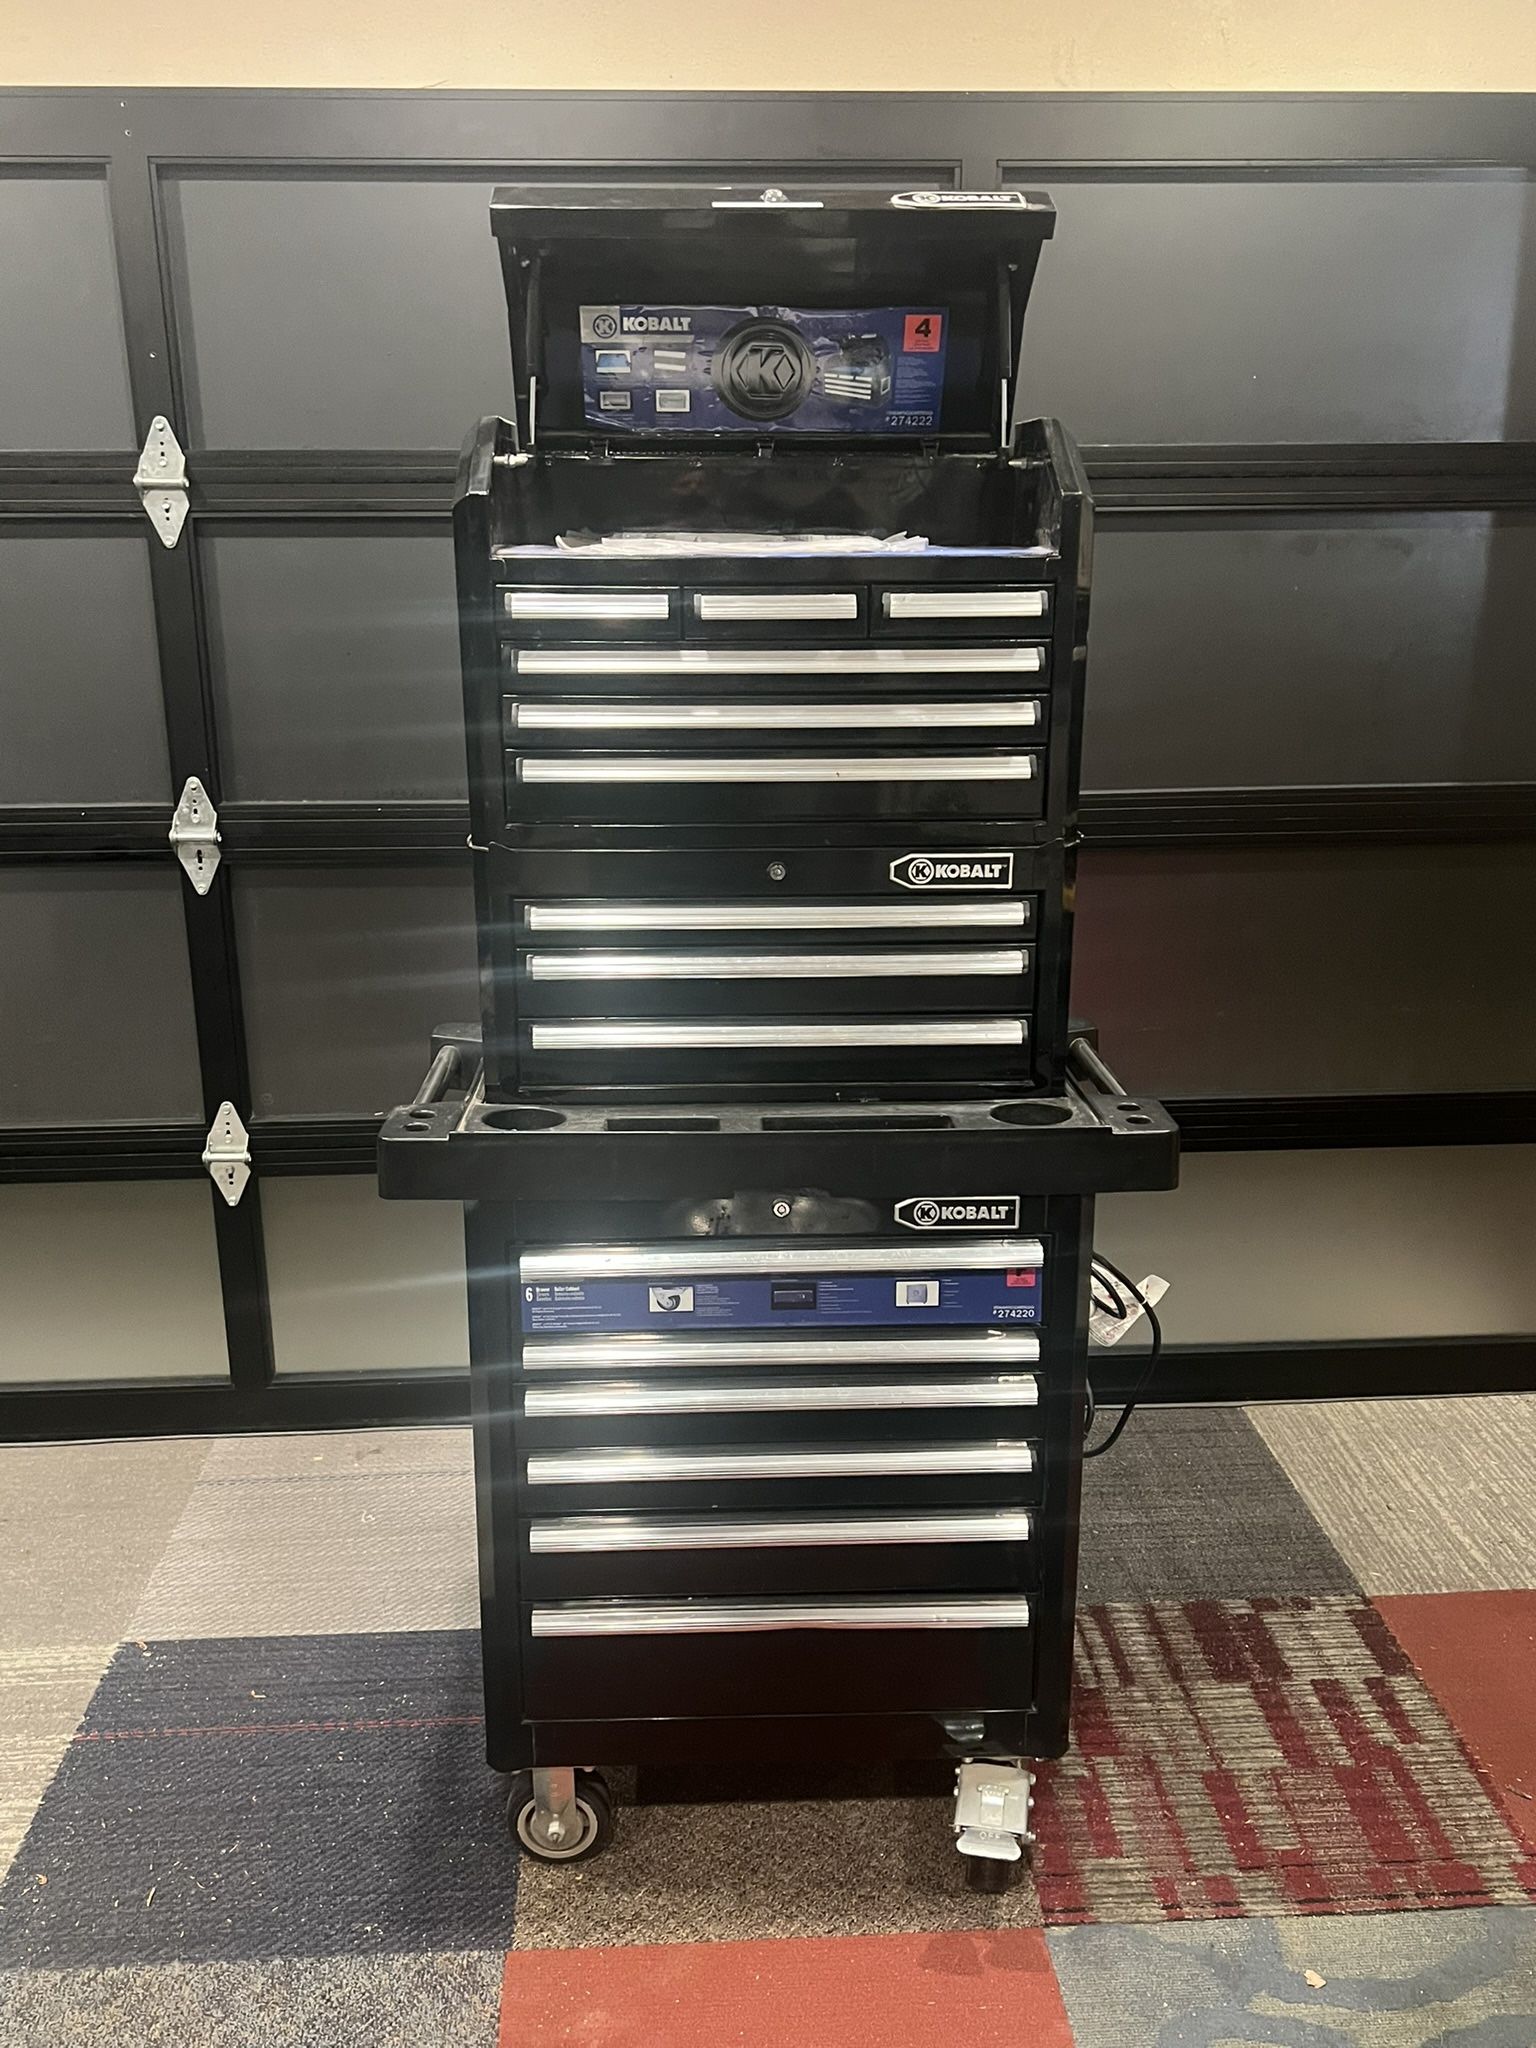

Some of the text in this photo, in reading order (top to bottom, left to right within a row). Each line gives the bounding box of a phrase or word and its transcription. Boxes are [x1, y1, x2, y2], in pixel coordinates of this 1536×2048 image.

[622, 316, 692, 332] KOBALT
[914, 318, 932, 338] 4
[935, 864, 1002, 878] KOBALT
[941, 1206, 1009, 1220] KOBALT
[525, 1287, 534, 1302] 6
